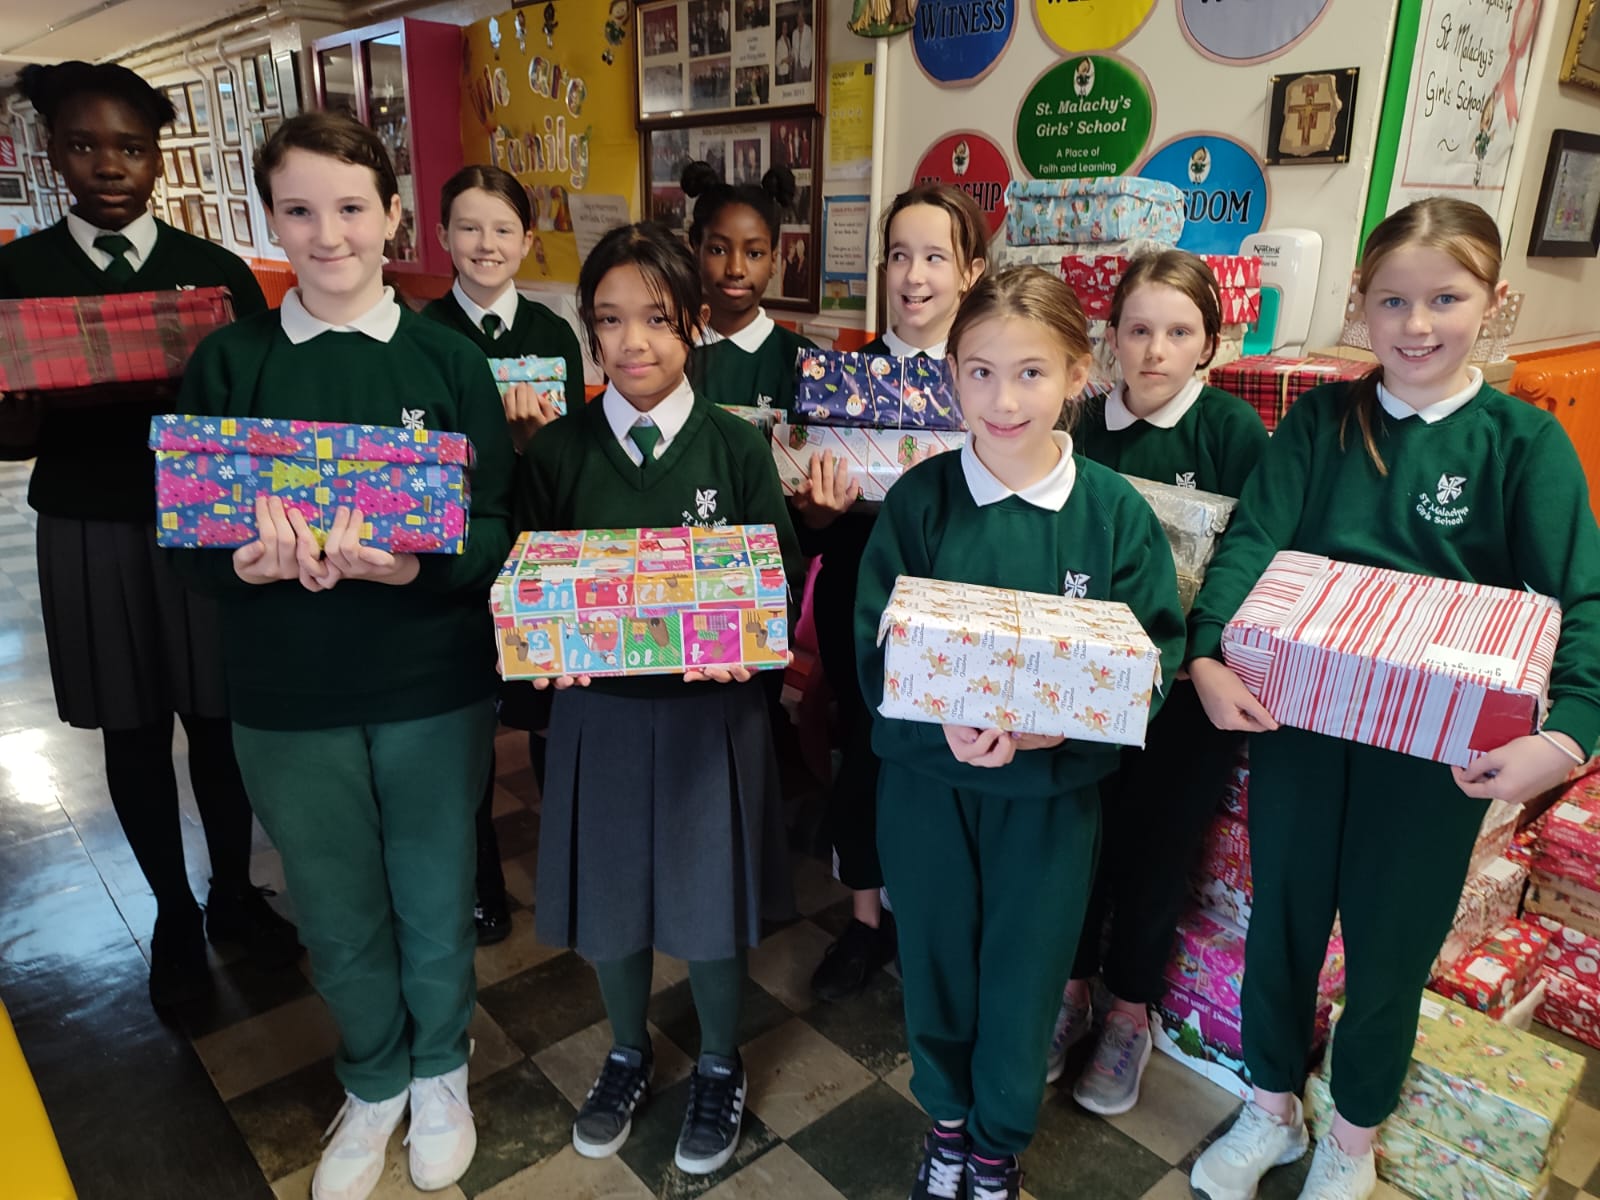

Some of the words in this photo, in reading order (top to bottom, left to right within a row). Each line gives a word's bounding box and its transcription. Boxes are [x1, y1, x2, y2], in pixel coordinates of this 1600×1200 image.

[920, 0, 1006, 41] WITNESS
[528, 56, 586, 118] are
[1035, 102, 1053, 116] St.
[1057, 95, 1132, 114] Malachy's
[1456, 79, 1485, 120] School
[1036, 121, 1074, 137] Girls'
[1077, 117, 1127, 134] School
[490, 115, 589, 190] Family
[1056, 149, 1063, 158] A
[1065, 147, 1088, 158] Place
[1090, 146, 1100, 157] of
[1039, 163, 1059, 174] Faith
[1060, 162, 1077, 173] and
[1079, 161, 1117, 174] Learning
[617, 584, 628, 605] 8
[628, 649, 654, 665] 10
[690, 643, 704, 663] 4
